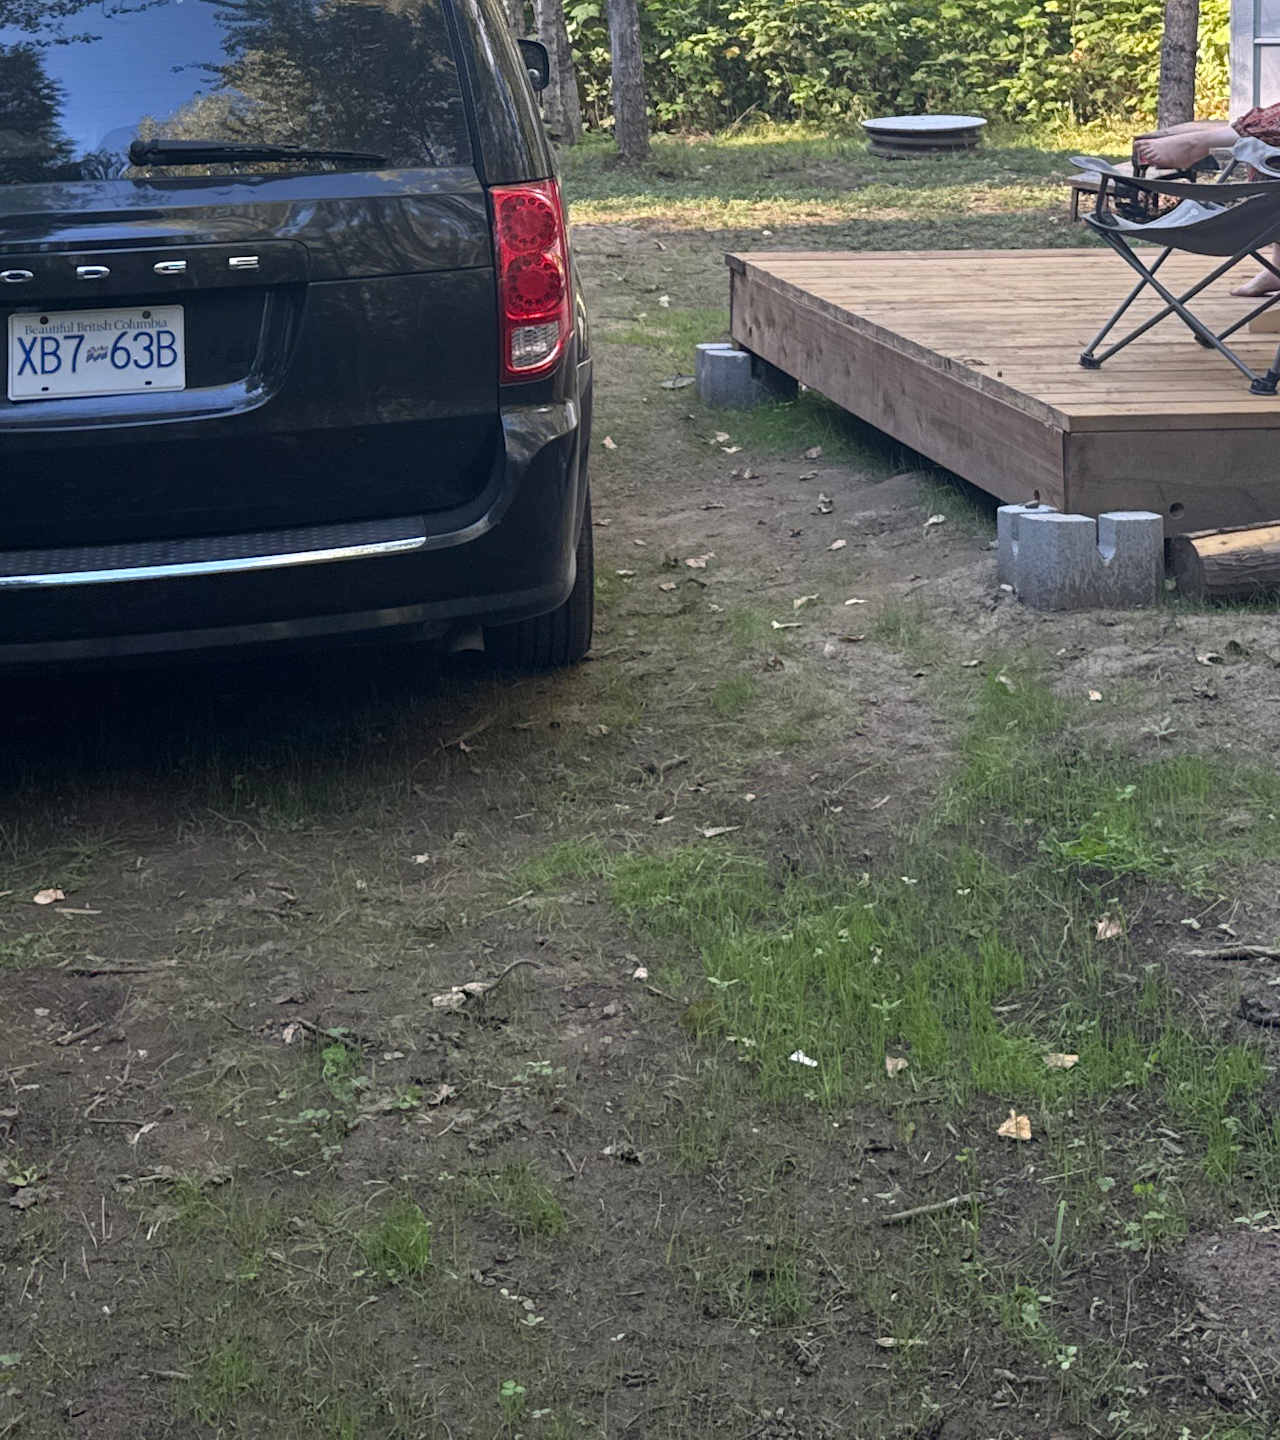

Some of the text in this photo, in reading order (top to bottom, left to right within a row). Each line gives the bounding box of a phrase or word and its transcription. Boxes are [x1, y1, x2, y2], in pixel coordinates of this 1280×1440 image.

[25, 318, 168, 335] Beautiful British Columbia
[17, 330, 178, 376] XB7 63B
